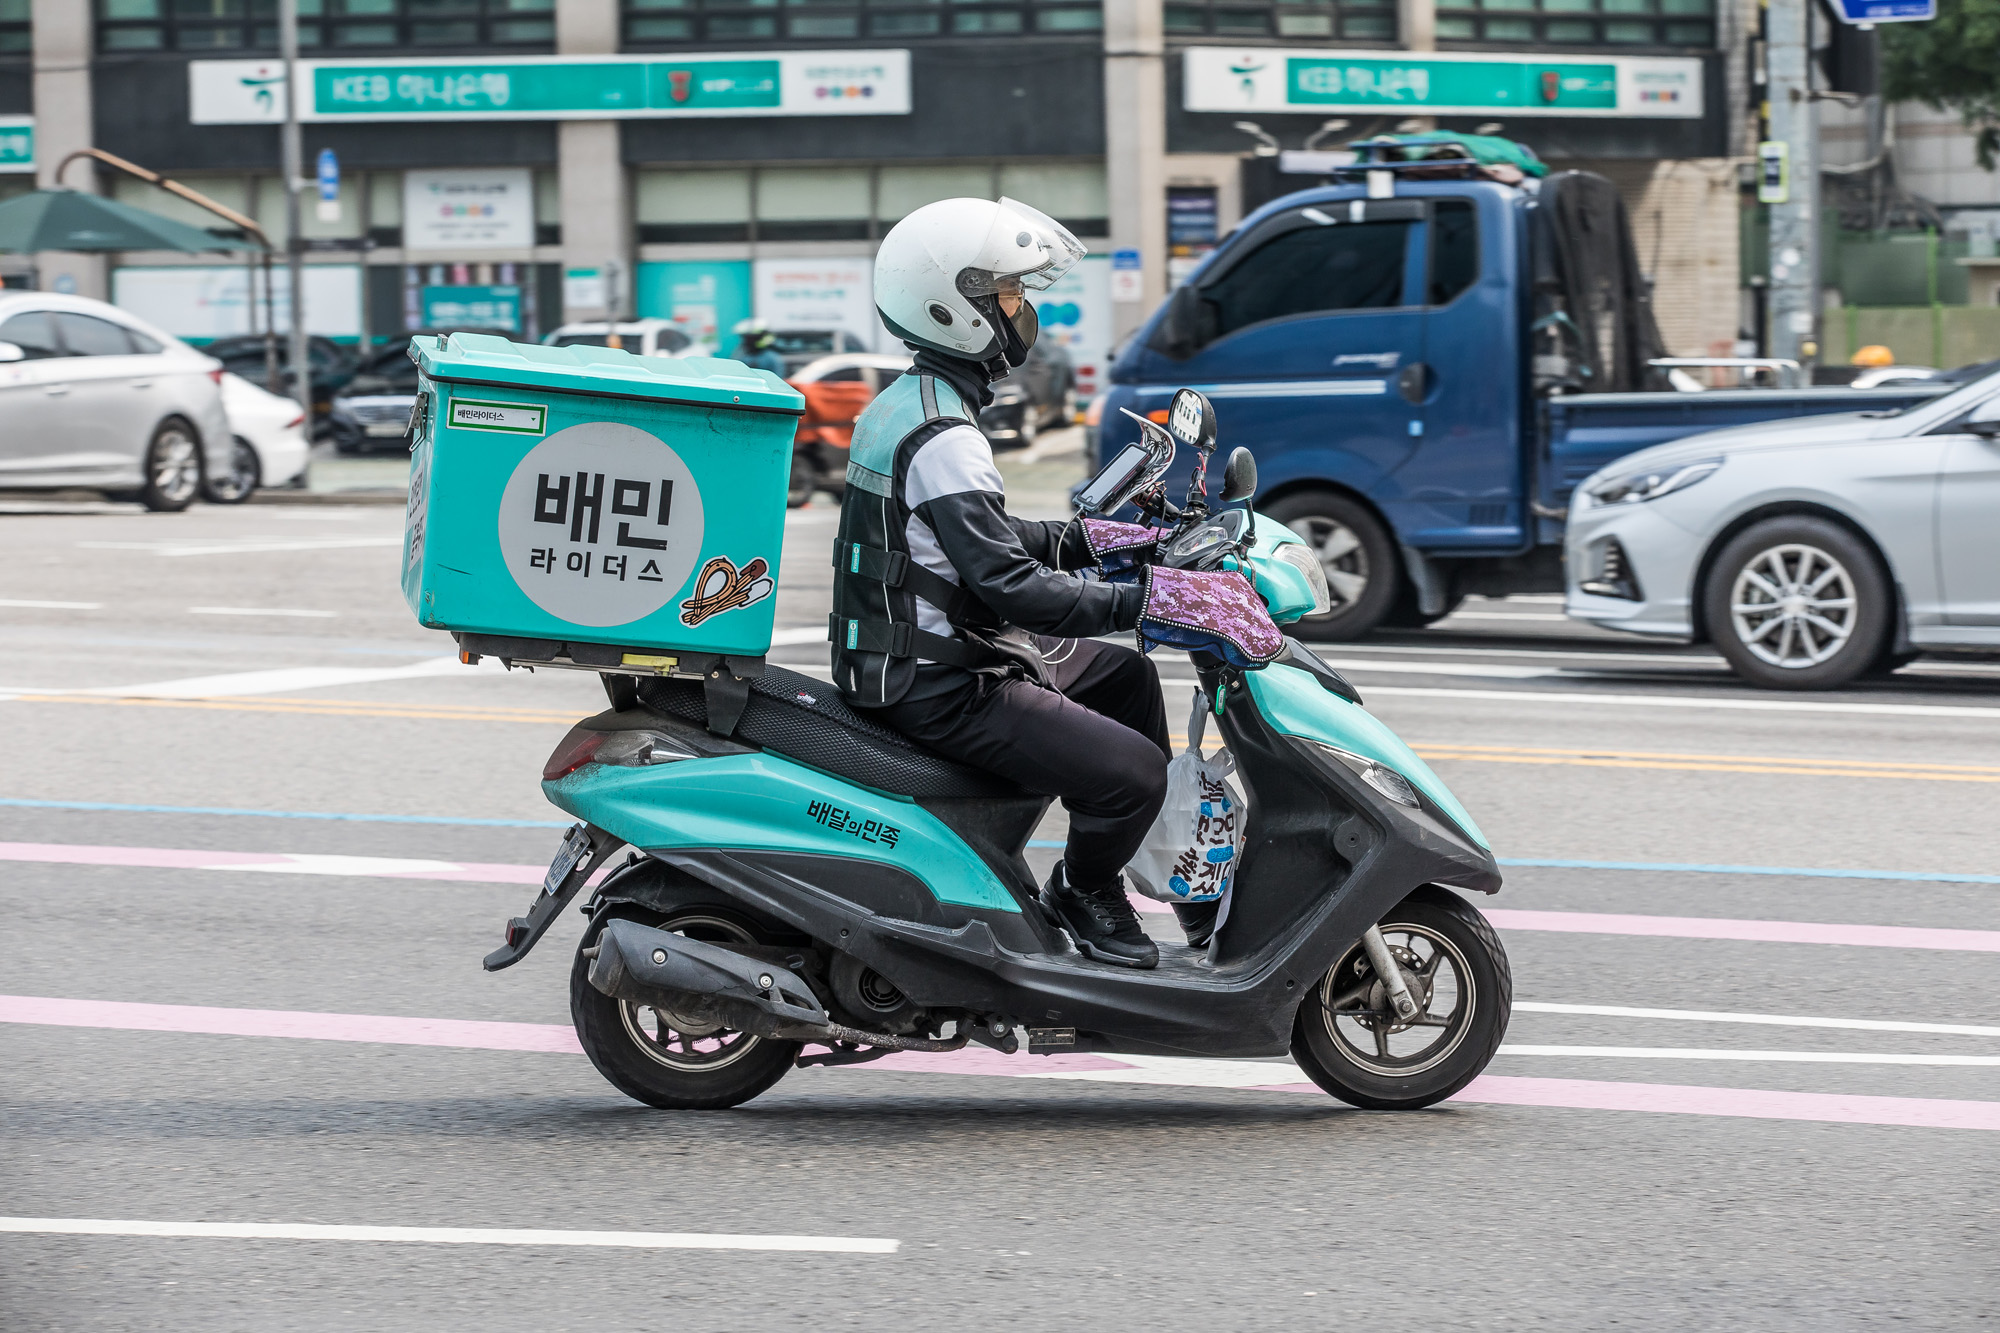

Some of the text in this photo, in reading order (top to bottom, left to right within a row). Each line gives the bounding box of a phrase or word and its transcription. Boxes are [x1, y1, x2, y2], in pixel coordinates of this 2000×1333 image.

[457, 409, 505, 421] 배민라이더스
[534, 471, 673, 551] 배민
[530, 547, 663, 582] 라이더스
[806, 799, 901, 850] 배달의민족
